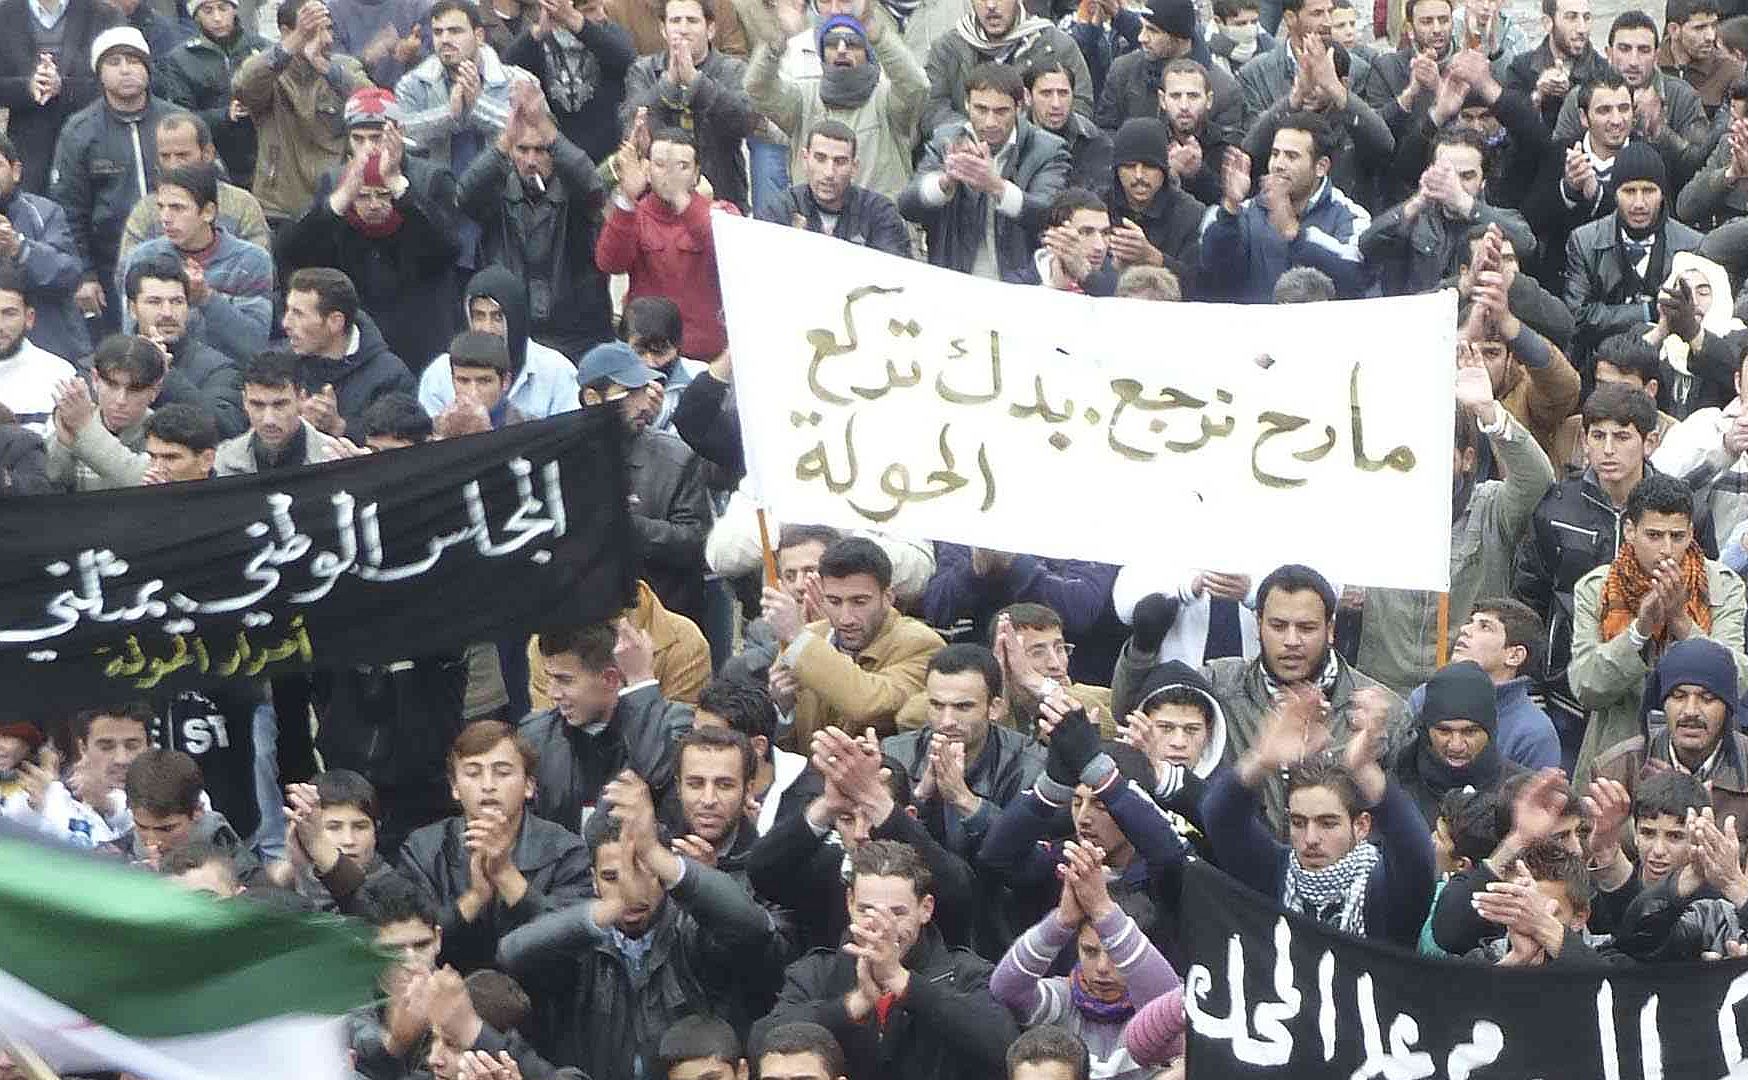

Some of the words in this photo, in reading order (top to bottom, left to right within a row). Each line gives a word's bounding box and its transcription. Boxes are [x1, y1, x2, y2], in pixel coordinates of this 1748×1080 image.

[806, 284, 922, 407] تركع
[349, 456, 567, 584] المجلس
[789, 410, 996, 524] الحولة
[198, 491, 384, 628] الوطني
[1184, 914, 1338, 1067] المحك
